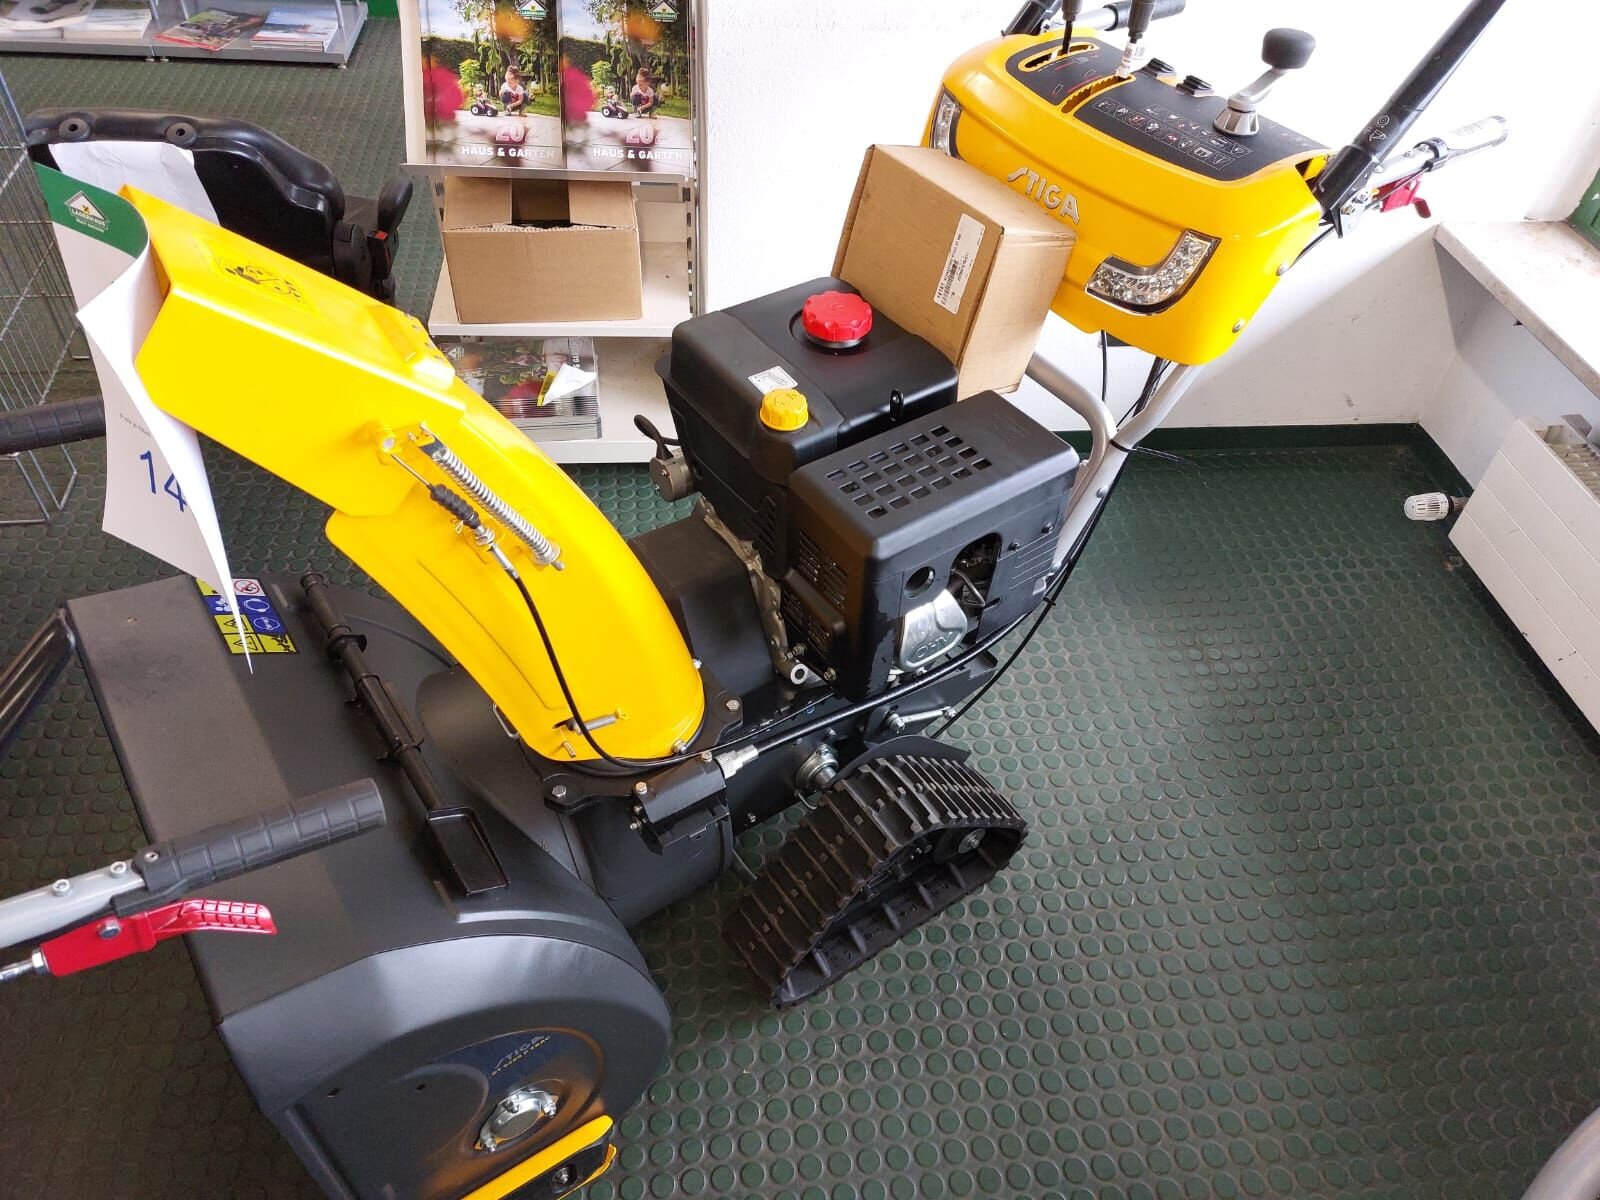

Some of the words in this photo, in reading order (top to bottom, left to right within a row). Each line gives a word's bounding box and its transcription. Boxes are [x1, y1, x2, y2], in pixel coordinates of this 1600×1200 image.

[461, 146, 494, 157] HAUS
[497, 148, 506, 157] &
[508, 148, 555, 160] GARTEN
[593, 147, 624, 159] HAUS
[627, 149, 636, 159] &
[638, 150, 683, 160] GARTEN
[1007, 167, 1080, 225] STIGA
[494, 1035, 546, 1069] STIGA
